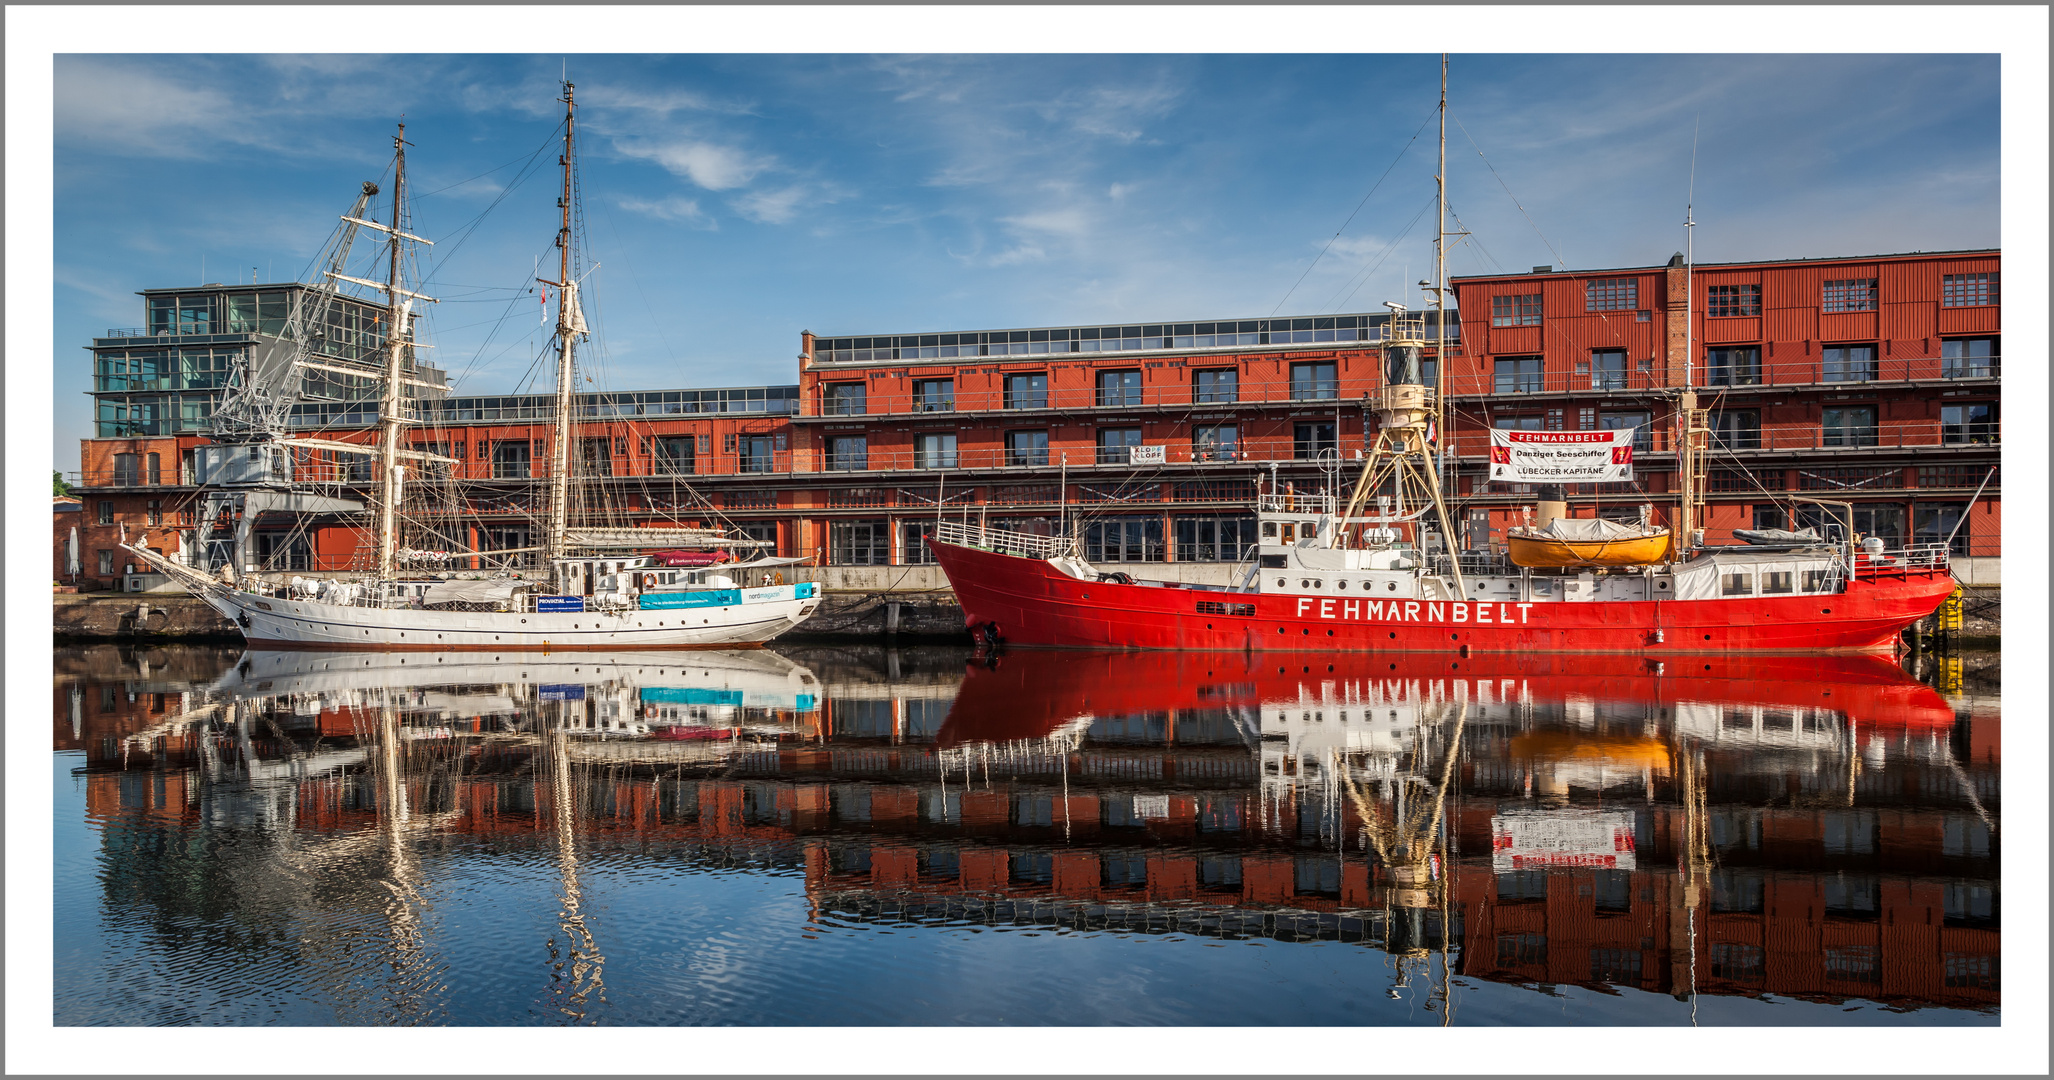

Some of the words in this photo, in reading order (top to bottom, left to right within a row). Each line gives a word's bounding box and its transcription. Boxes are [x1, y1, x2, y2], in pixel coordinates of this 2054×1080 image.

[1518, 434, 1605, 442] FEHMARNBELT
[1516, 450, 1554, 458] Danziger
[1556, 450, 1606, 458] Seeschiffer
[1517, 467, 1561, 475] LÜBECKER
[1563, 467, 1604, 475] KAPITÄNE
[1297, 598, 1533, 624] FEHMARNBELT
